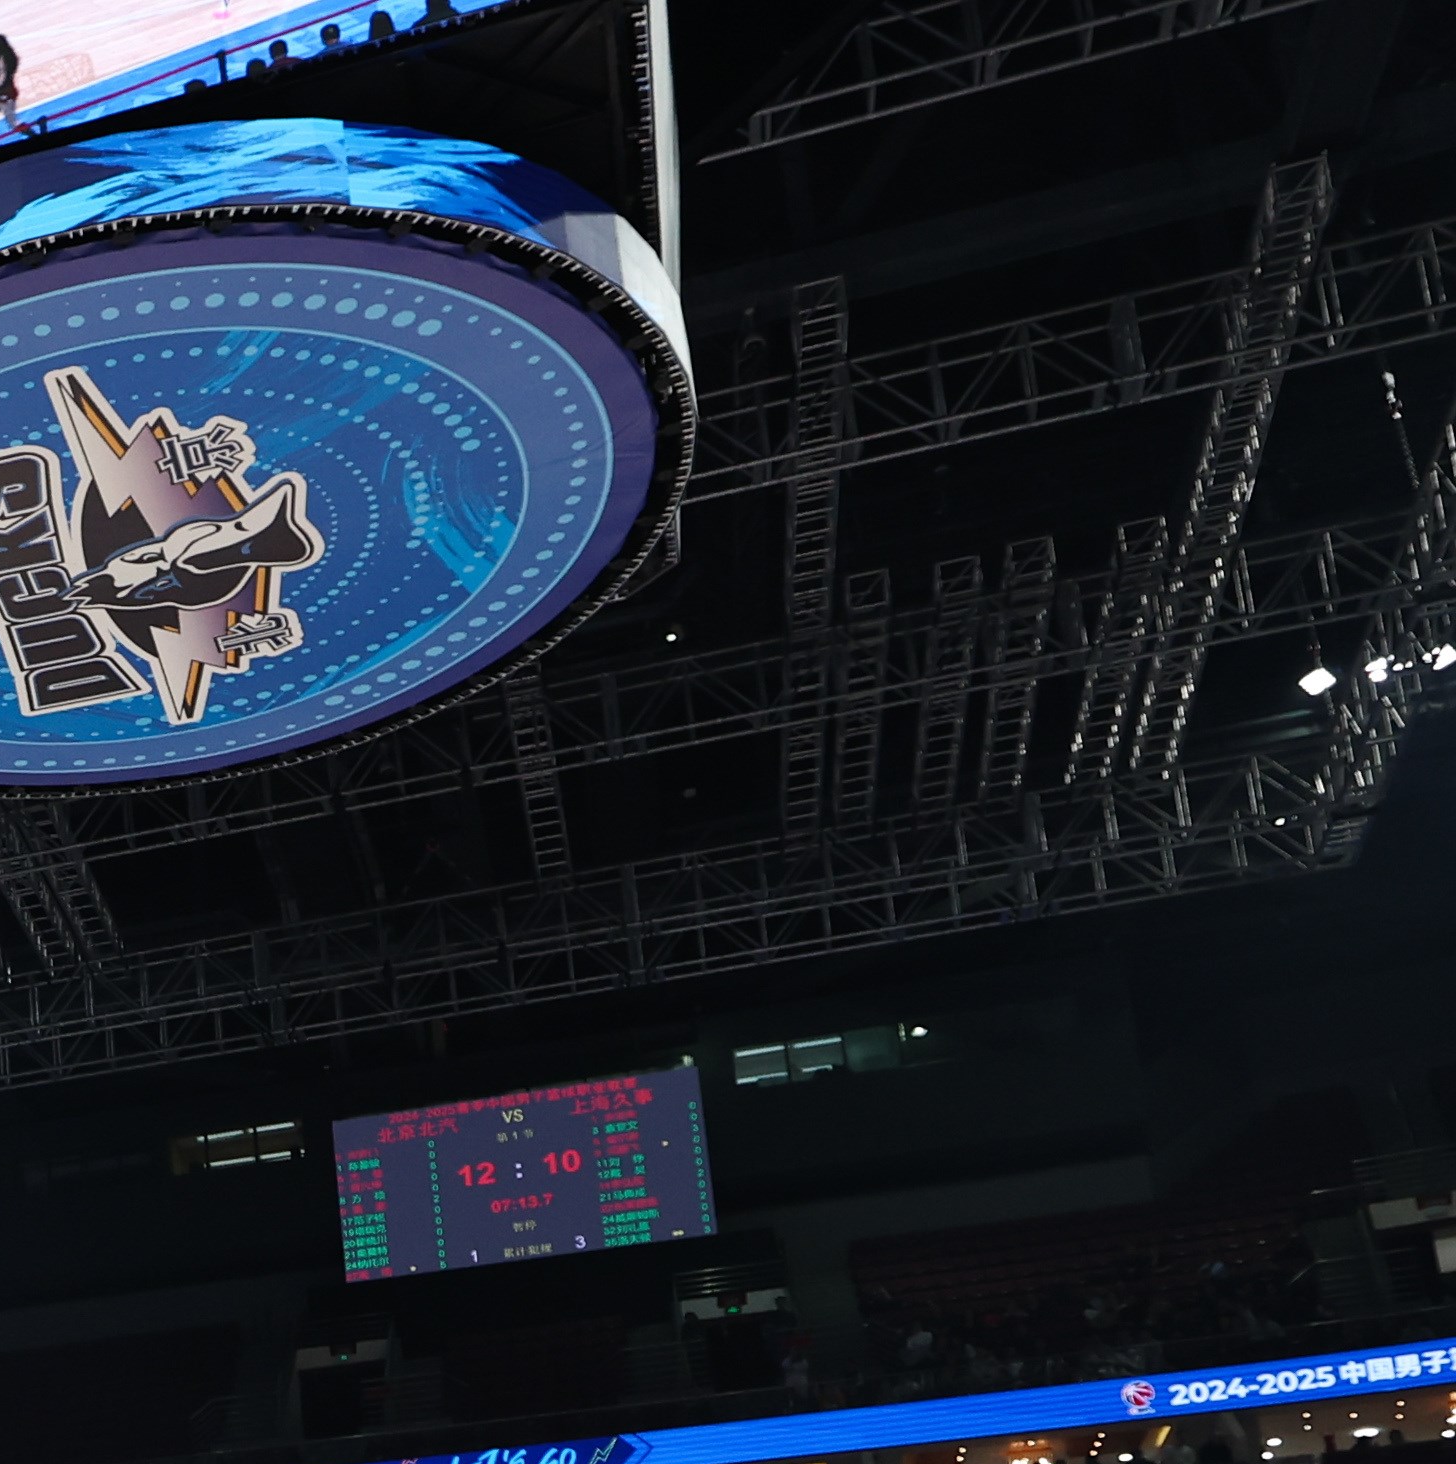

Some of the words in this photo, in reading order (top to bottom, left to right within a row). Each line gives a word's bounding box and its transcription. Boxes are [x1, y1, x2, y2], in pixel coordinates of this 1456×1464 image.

[501, 1109, 525, 1125] VS
[456, 1161, 497, 1187] 12
[542, 1149, 582, 1175] 10
